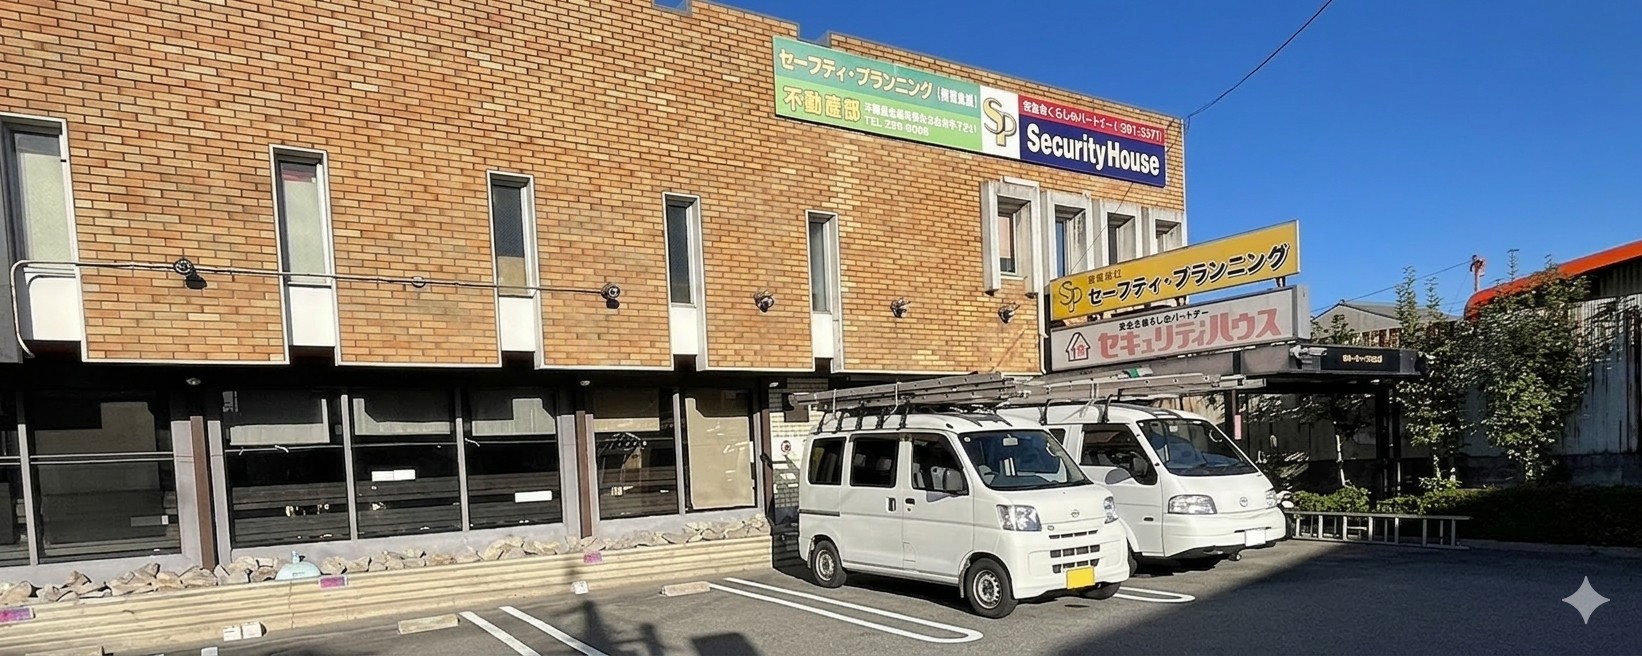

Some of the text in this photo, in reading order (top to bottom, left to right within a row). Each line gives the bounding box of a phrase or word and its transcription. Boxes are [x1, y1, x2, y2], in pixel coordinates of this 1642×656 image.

[864, 116, 882, 128] TEL
[1097, 308, 1282, 359] セキュリティハウス
